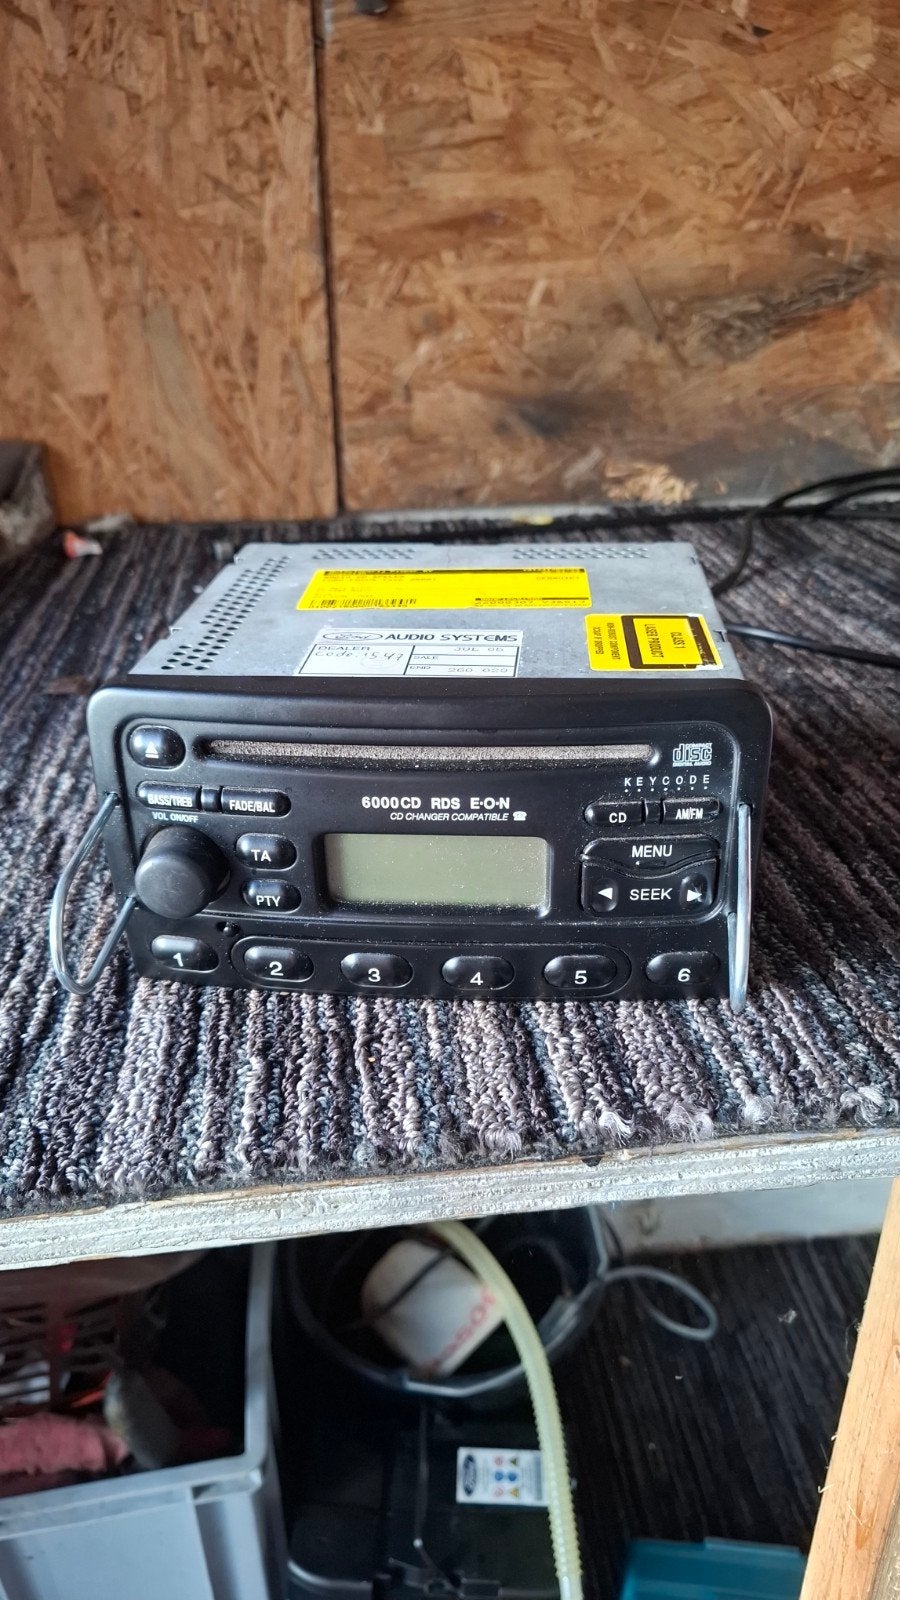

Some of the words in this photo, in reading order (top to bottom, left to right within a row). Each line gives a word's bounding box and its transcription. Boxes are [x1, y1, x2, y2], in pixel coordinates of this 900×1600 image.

[440, 634, 518, 642] SYSTEMS
[148, 794, 193, 807] BASS/TREB
[229, 800, 276, 813] FADE/BAL
[361, 796, 422, 809] 6000CD
[431, 797, 461, 810] RDS
[152, 811, 169, 820] VOL
[170, 813, 199, 823] ON/OFF
[390, 812, 404, 821] CD
[405, 812, 450, 821] CHANGER
[451, 813, 510, 821] COMPATIBLE
[609, 812, 627, 824] CD
[675, 807, 703, 820] AM/FM
[250, 849, 272, 862] TA
[631, 845, 672, 858] MENU
[629, 888, 673, 900] SEEK
[256, 895, 281, 907] PTY
[173, 952, 184, 967] 1
[269, 961, 284, 976] 2
[368, 968, 381, 982] 3
[677, 968, 691, 982] 6
[470, 972, 483, 986] 4
[574, 970, 588, 985] 5
